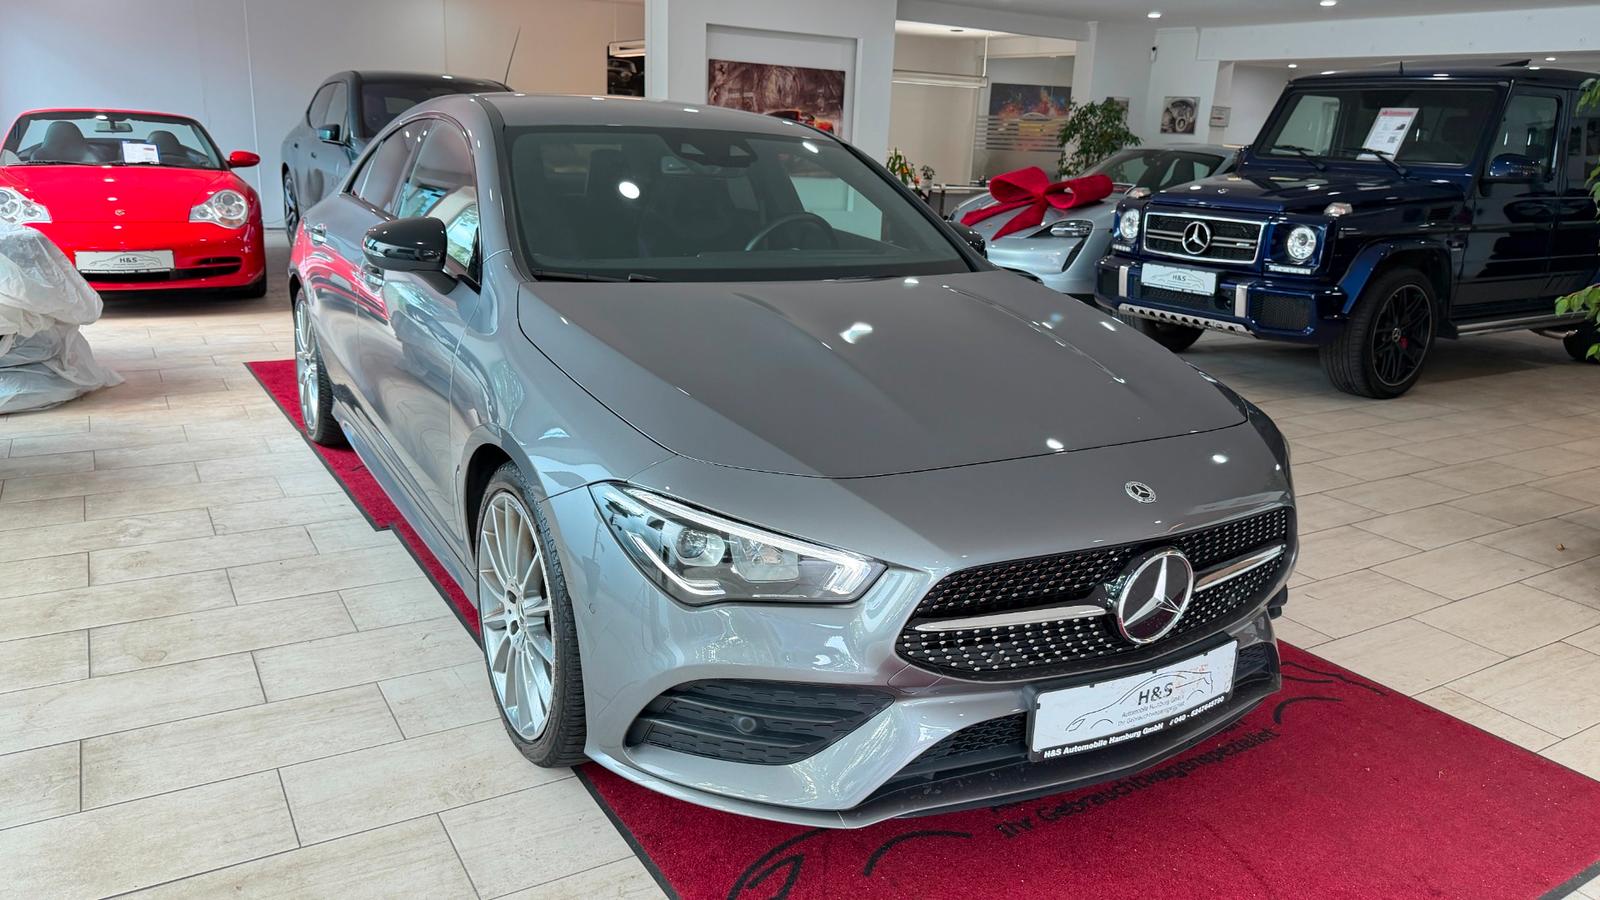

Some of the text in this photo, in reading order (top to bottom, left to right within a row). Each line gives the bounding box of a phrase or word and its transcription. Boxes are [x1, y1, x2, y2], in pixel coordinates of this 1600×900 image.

[1138, 682, 1173, 706] H&S
[1043, 722, 1164, 758] H&S Automobile Hamburg GmbH
